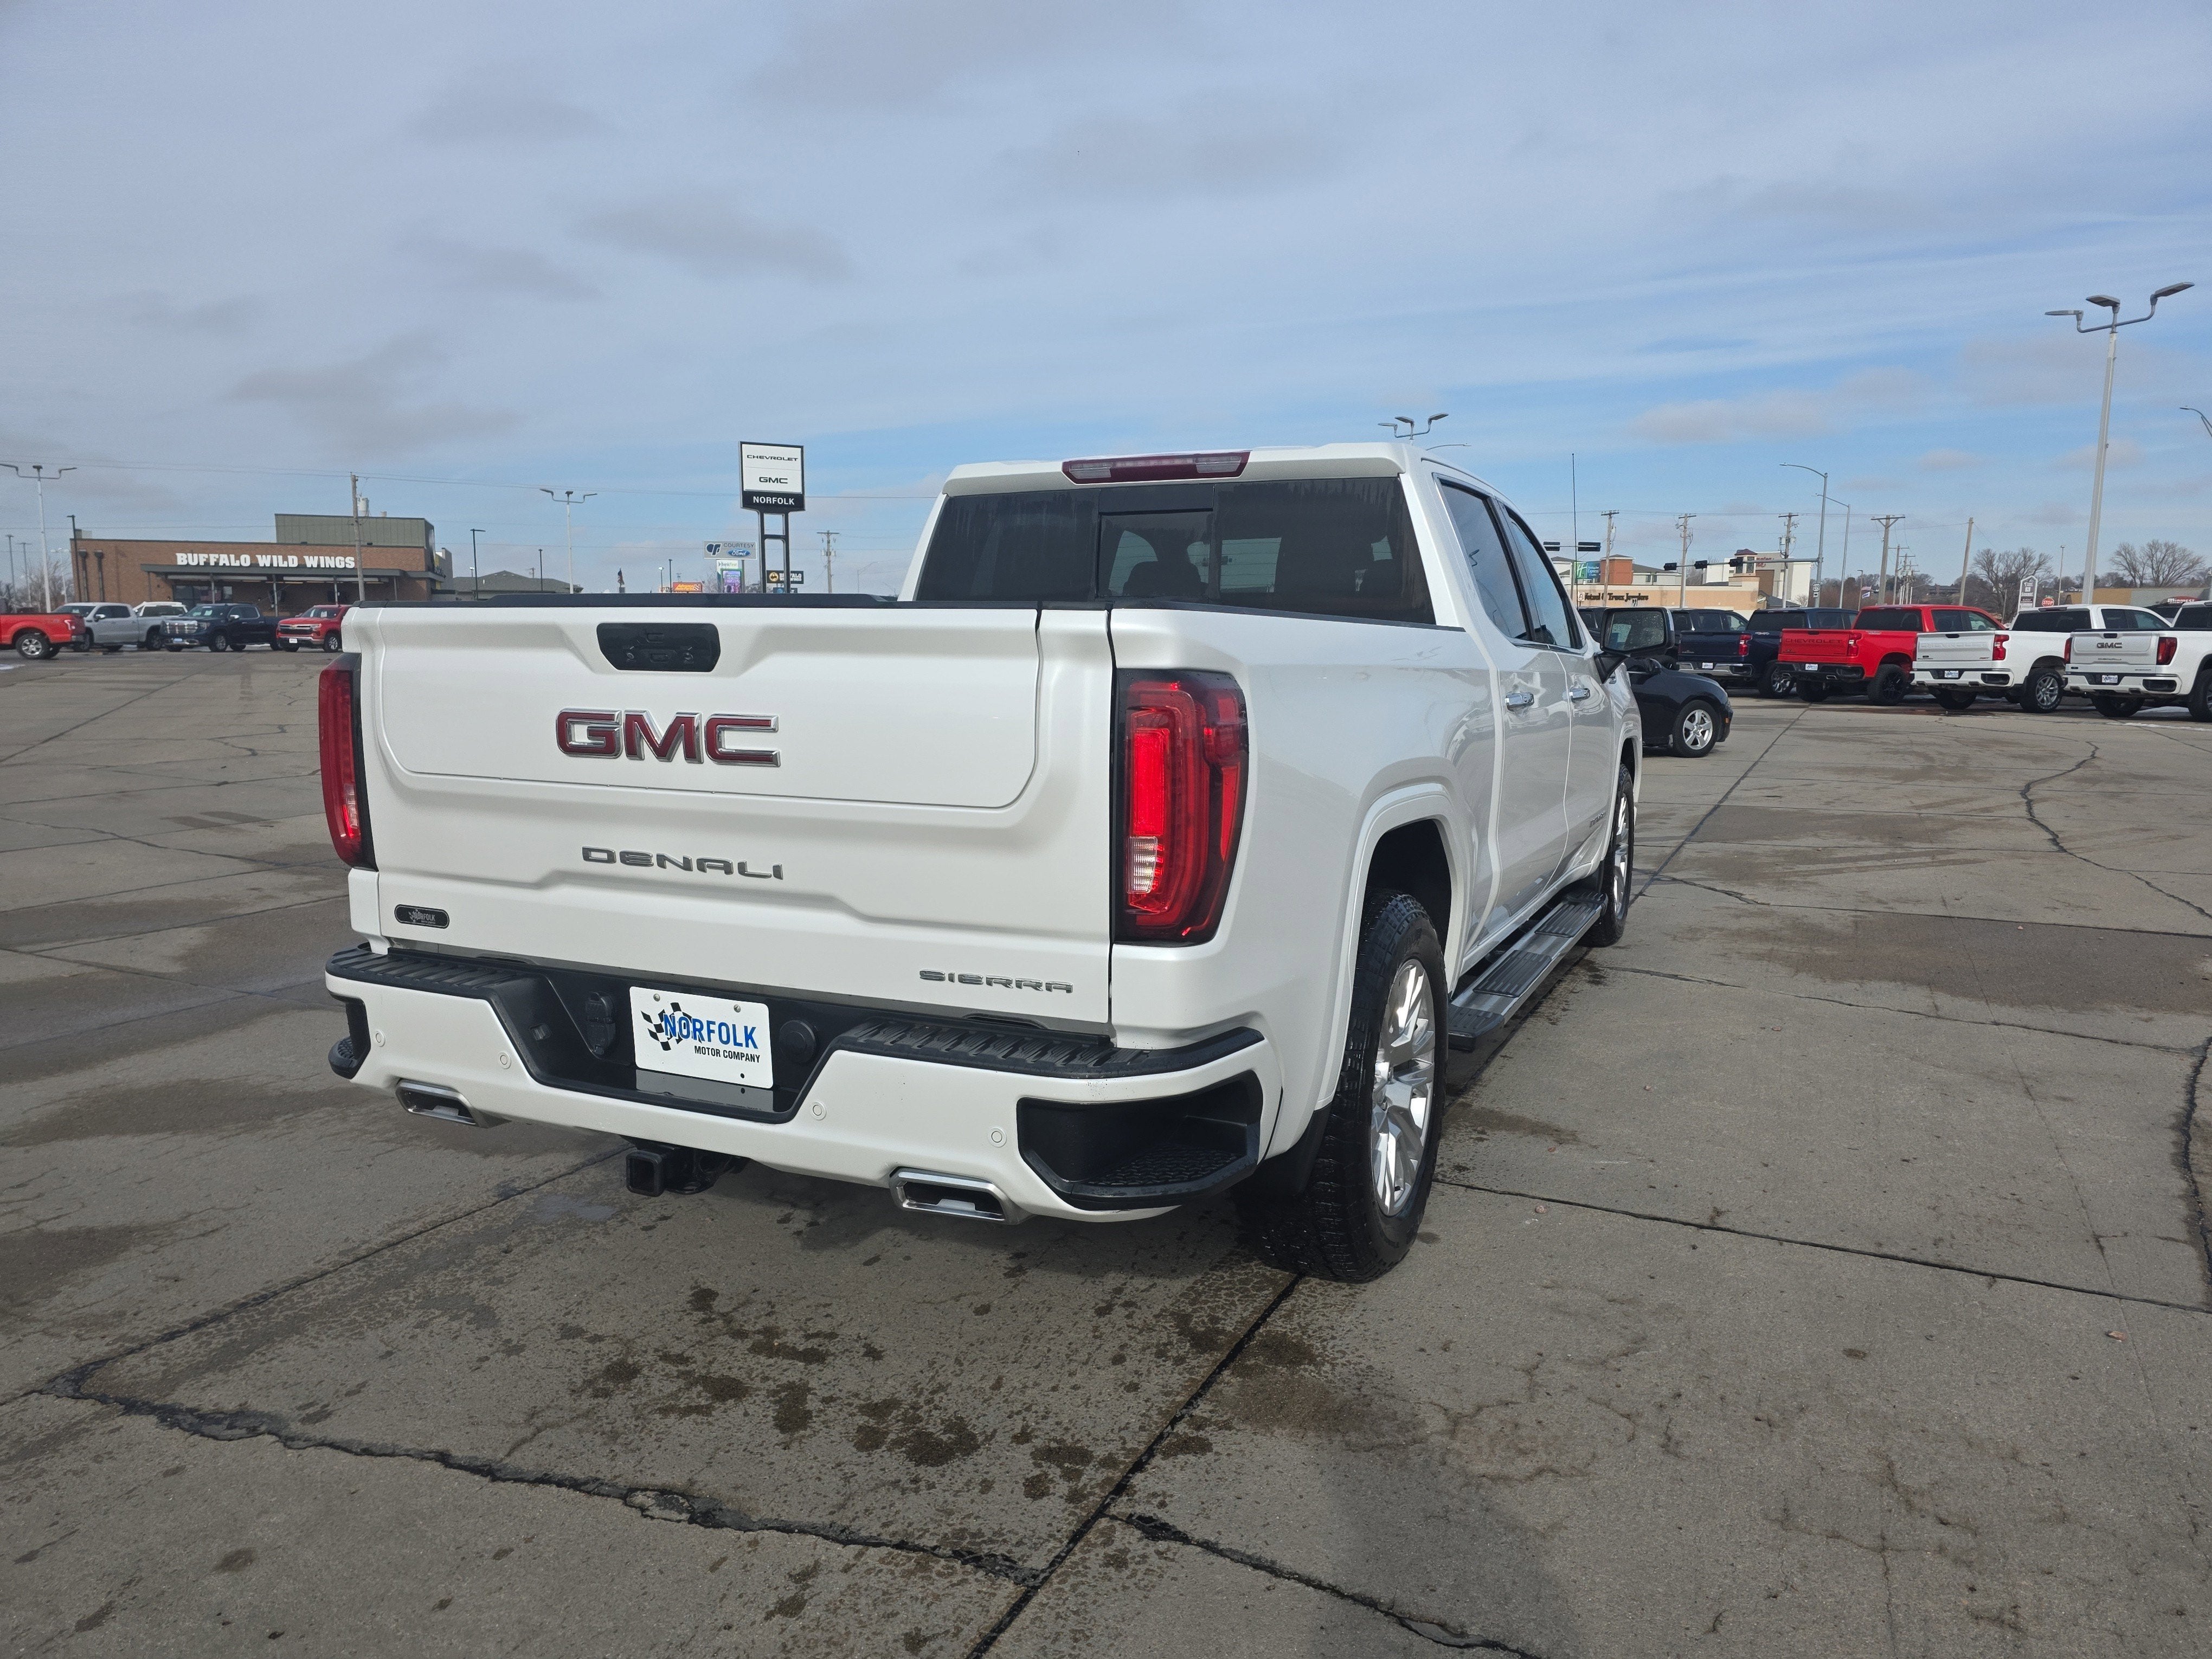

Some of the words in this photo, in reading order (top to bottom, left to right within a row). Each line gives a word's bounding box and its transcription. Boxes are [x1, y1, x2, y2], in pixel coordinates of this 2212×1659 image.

[753, 496, 795, 505] NORFOLK
[175, 552, 251, 567] BUFFALO
[255, 554, 298, 568] WILD
[303, 555, 356, 569] WINGS
[556, 707, 781, 768] GMC
[582, 845, 783, 880] DENALI
[919, 968, 1073, 994] SIERRA
[663, 1013, 758, 1050] NORFOLK
[694, 1045, 721, 1058] MOTOR
[723, 1050, 761, 1063] COMPANY
